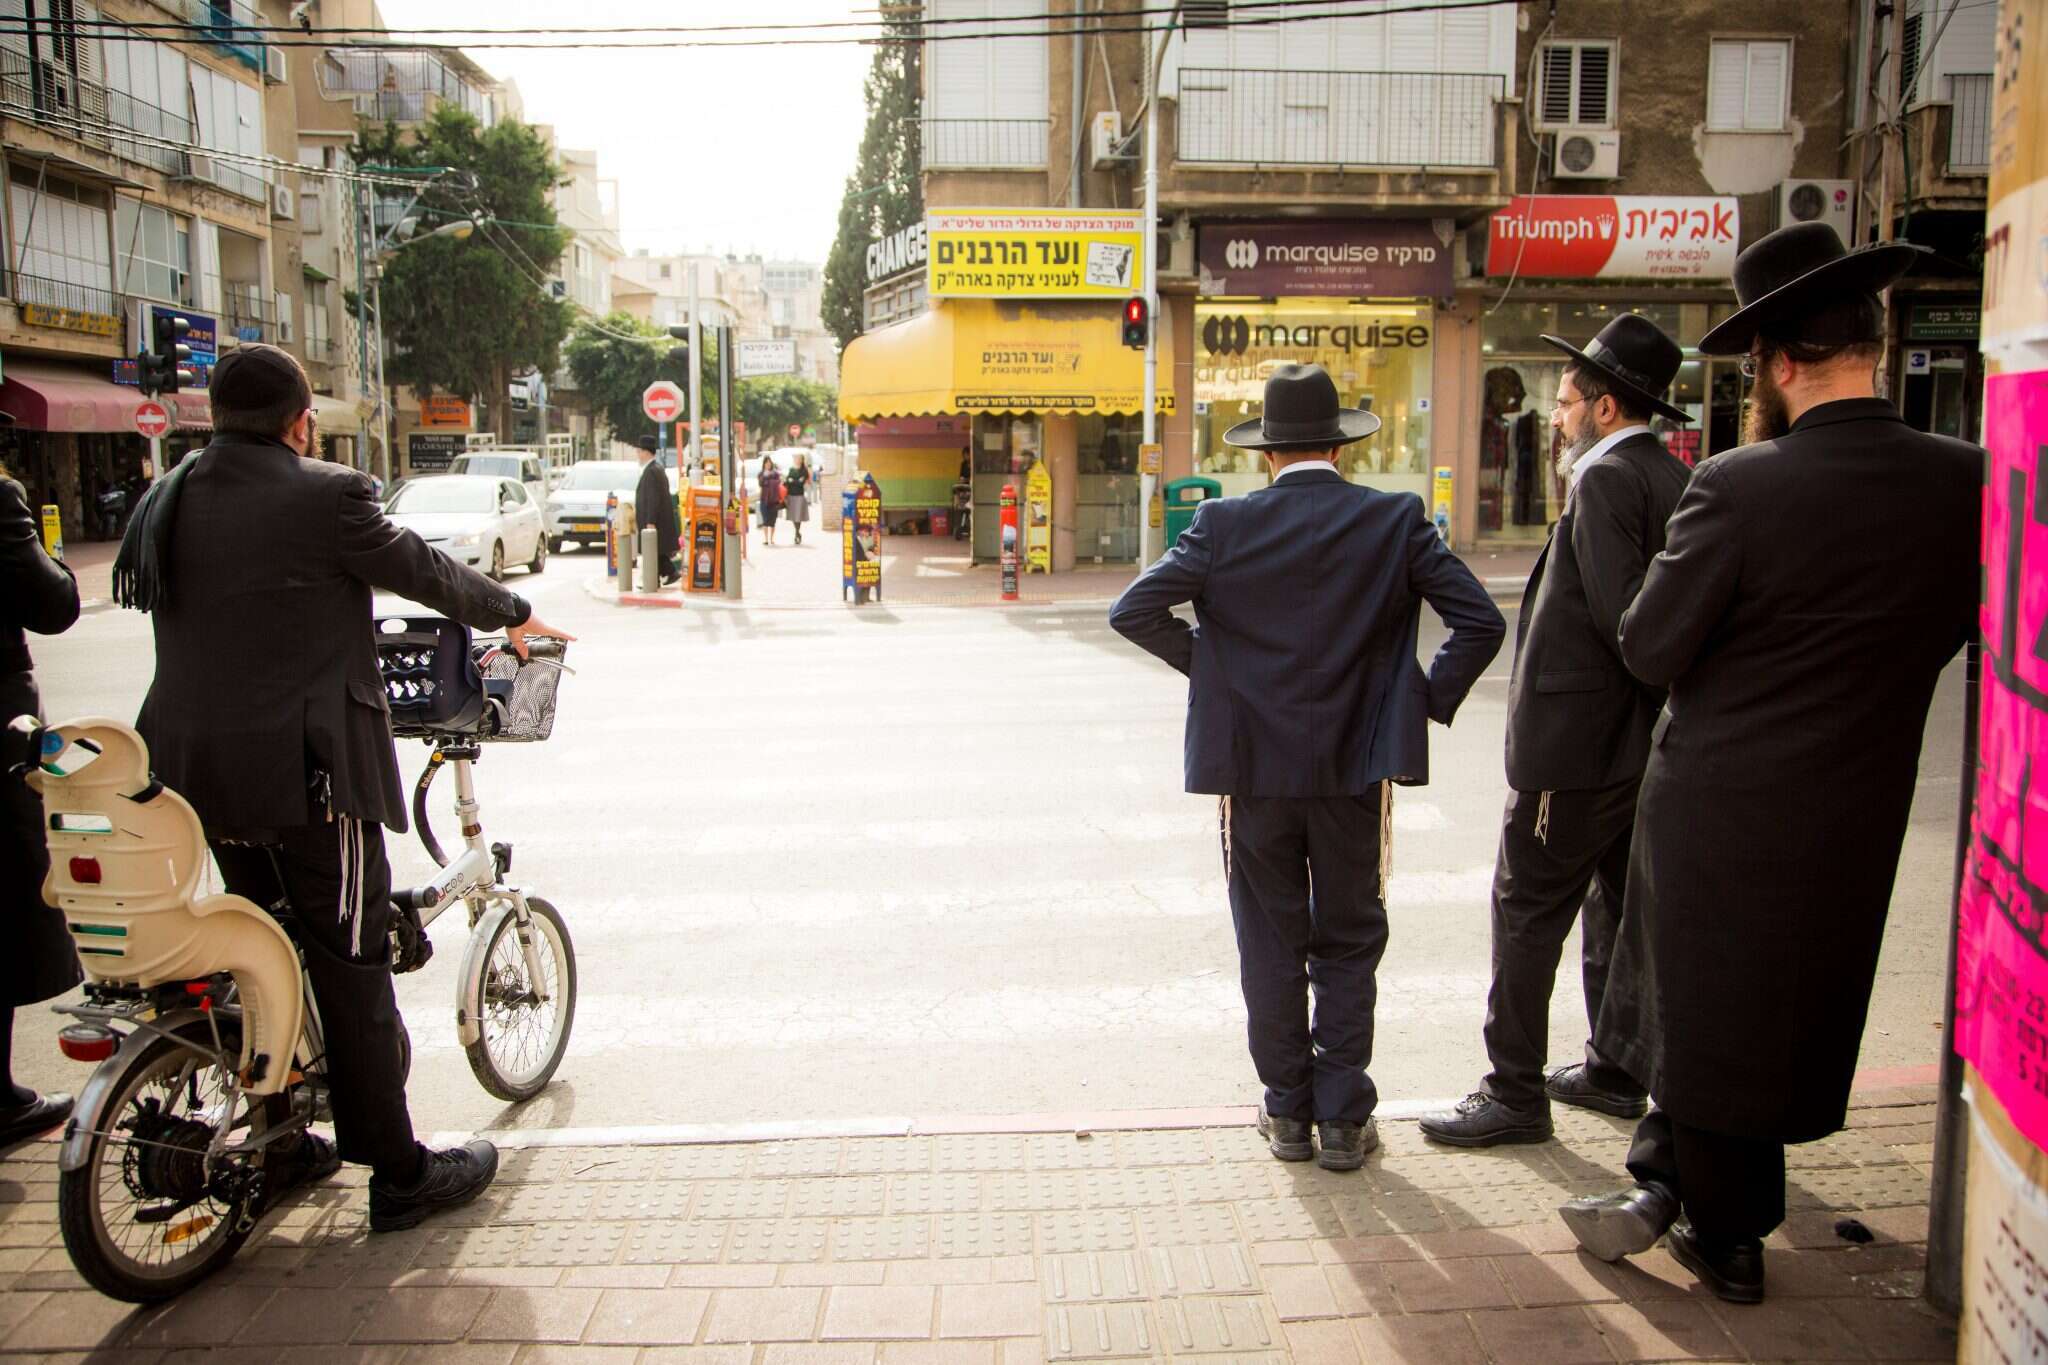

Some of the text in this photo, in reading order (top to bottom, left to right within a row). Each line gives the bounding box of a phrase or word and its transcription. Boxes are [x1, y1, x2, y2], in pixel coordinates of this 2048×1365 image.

[988, 218, 1013, 229] הדור
[1016, 216, 1045, 229] גדולי
[1048, 216, 1062, 229] של
[1065, 218, 1104, 231] הצדקה
[1107, 218, 1135, 232] מוקד
[1493, 214, 1593, 245] Triumph
[866, 221, 928, 280] CHANGE
[937, 241, 1080, 264] ועד הרבנים
[1266, 242, 1380, 265] marquise
[1385, 246, 1436, 266] מרקיז
[937, 271, 1079, 290] לעניני צדקה בארה"ק
[1255, 320, 1429, 354] marquise
[982, 351, 1054, 364] ועד הרבנים
